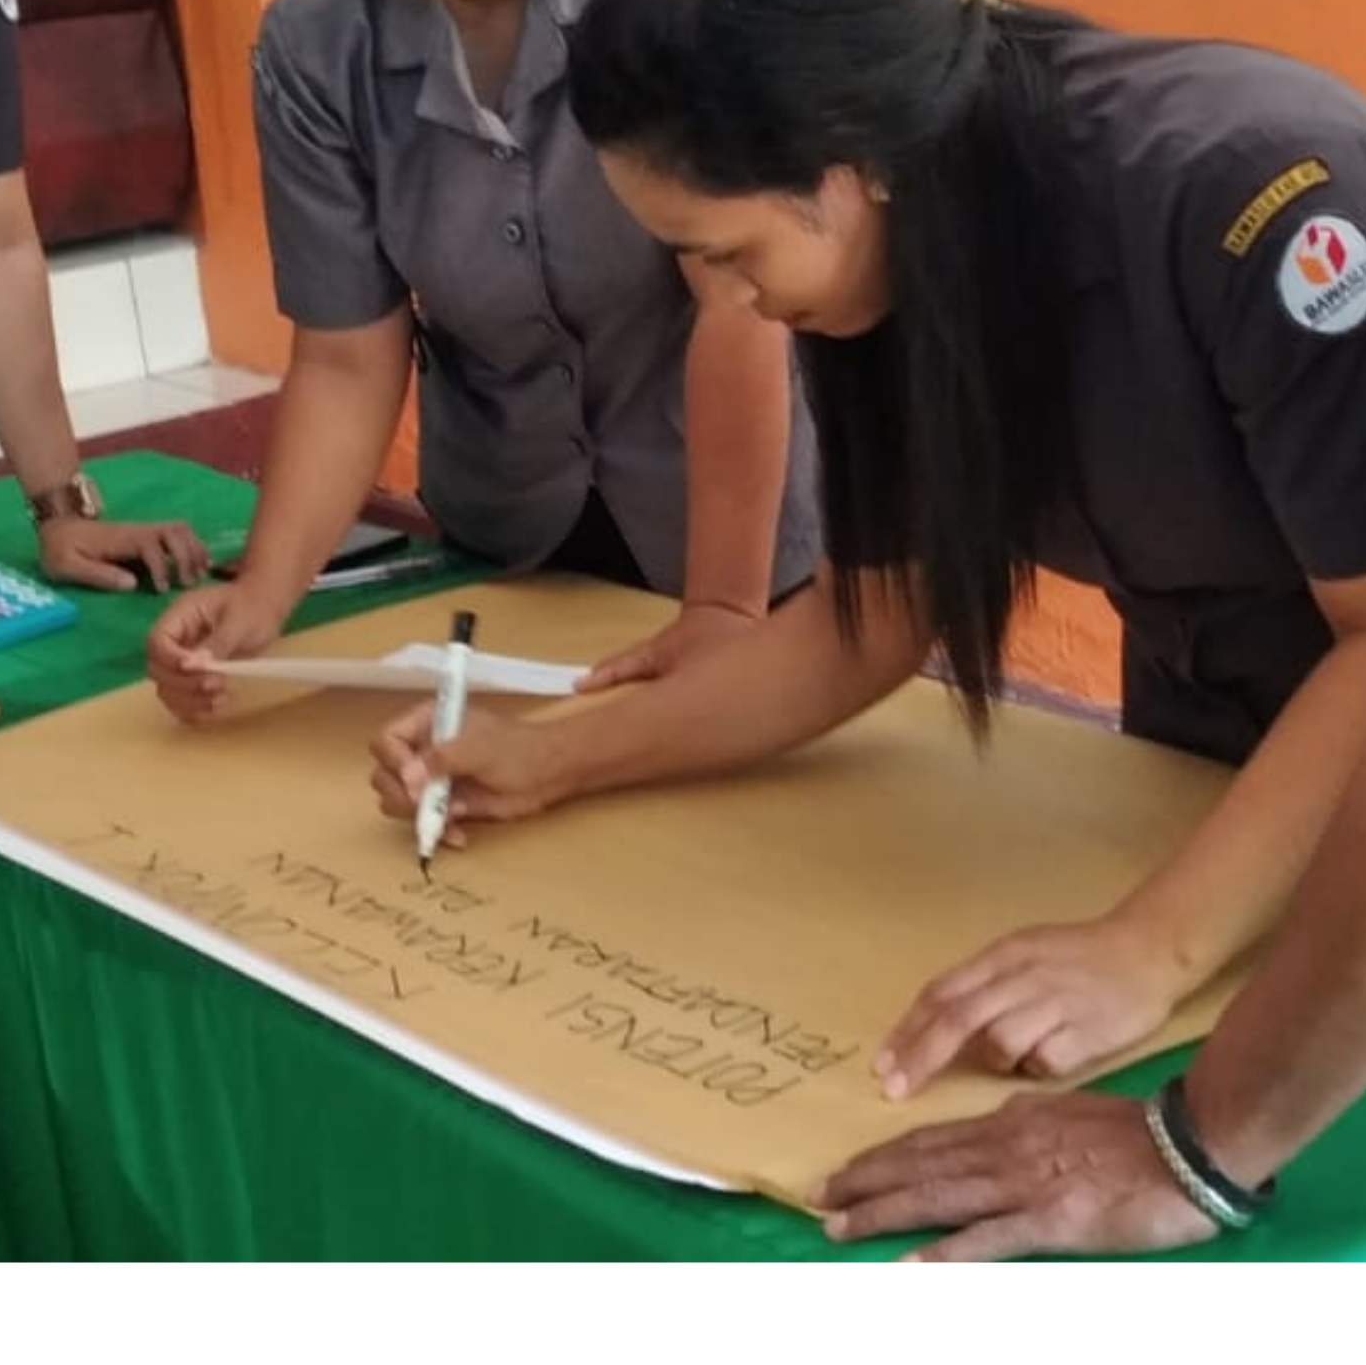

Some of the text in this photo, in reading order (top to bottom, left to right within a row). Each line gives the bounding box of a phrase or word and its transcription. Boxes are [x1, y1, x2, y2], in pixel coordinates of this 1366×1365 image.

[247, 852, 802, 1107] POTENSI KERAWANAN
[507, 914, 861, 1071] PENDAFTARAN
